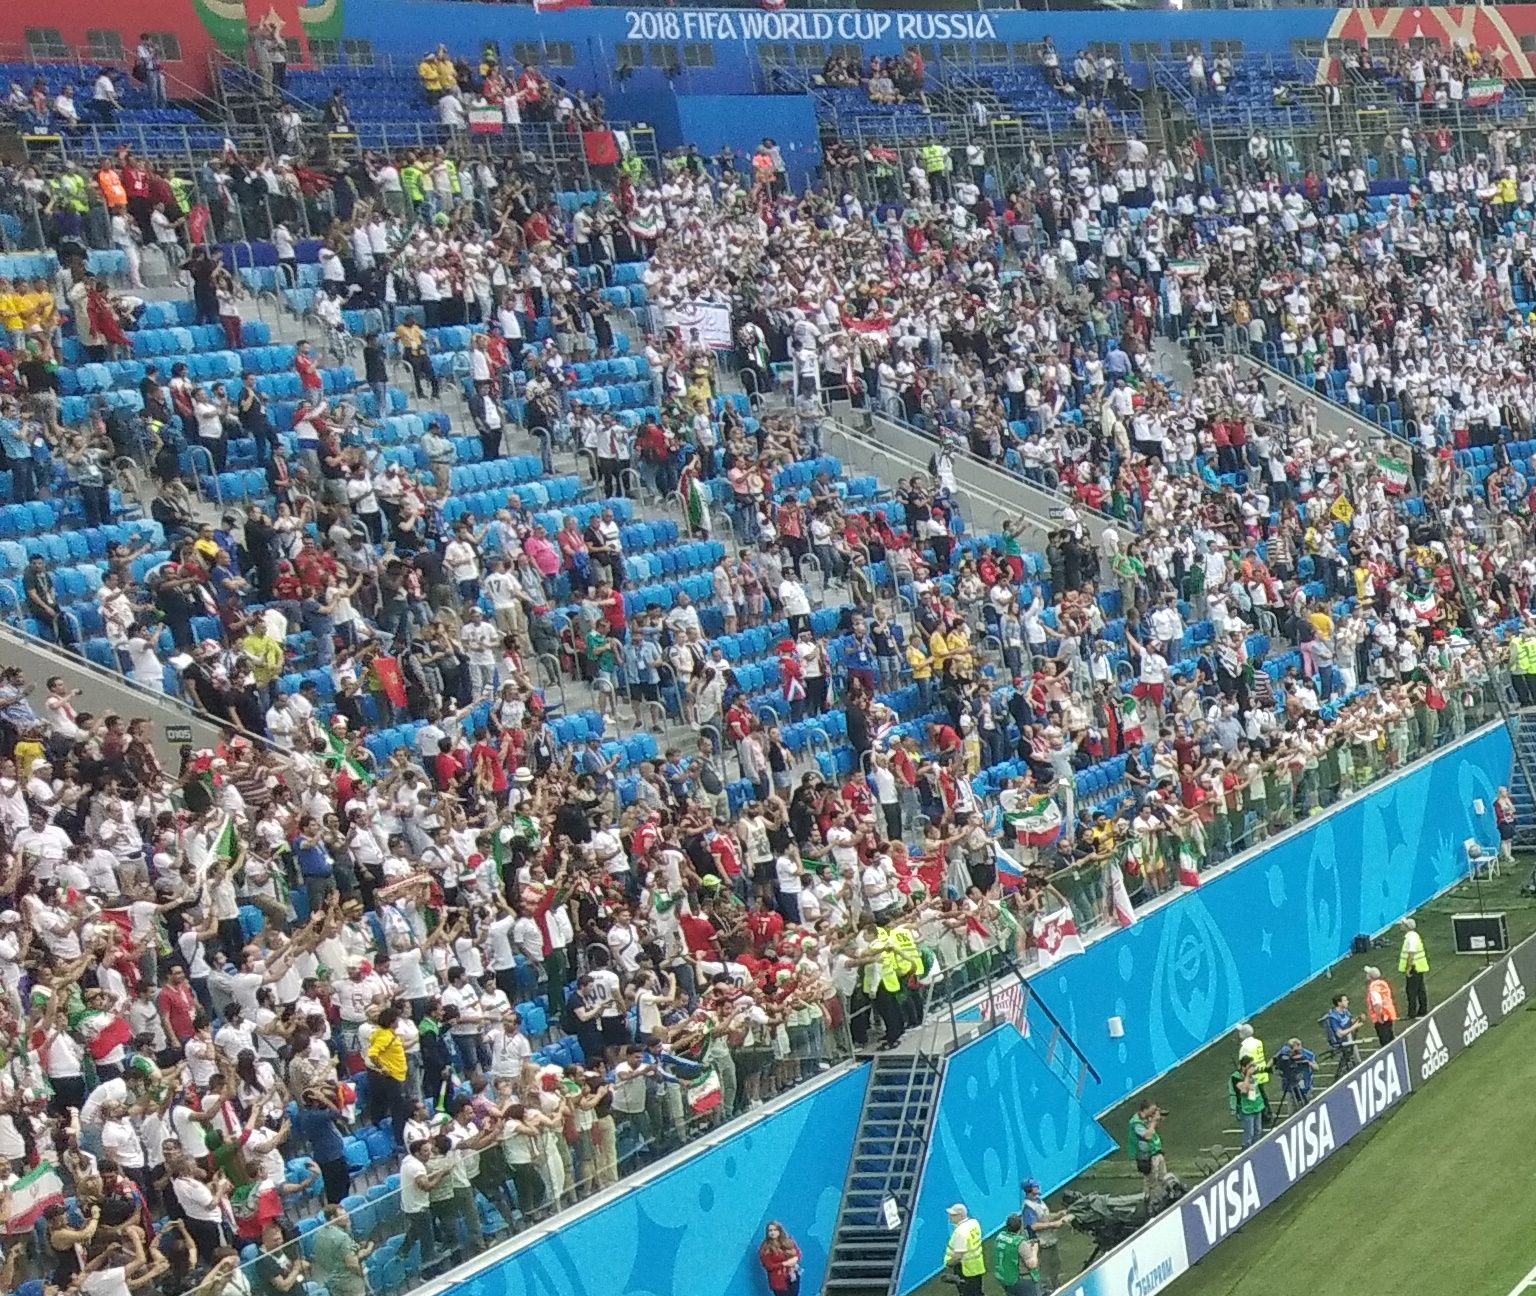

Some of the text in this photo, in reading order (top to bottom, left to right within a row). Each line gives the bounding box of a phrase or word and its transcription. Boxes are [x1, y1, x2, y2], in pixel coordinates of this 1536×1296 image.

[626, 12, 996, 40] 2018 FIFA WORLD CUP RUSSIA
[1502, 985, 1525, 1015] adidas
[1463, 1014, 1489, 1046] adidas
[1421, 1046, 1449, 1080] adidas
[1347, 1052, 1402, 1125] VISA
[1275, 1103, 1335, 1182] VISA
[1193, 1160, 1261, 1245] VISA
[1141, 1256, 1175, 1296] GAZPROM
